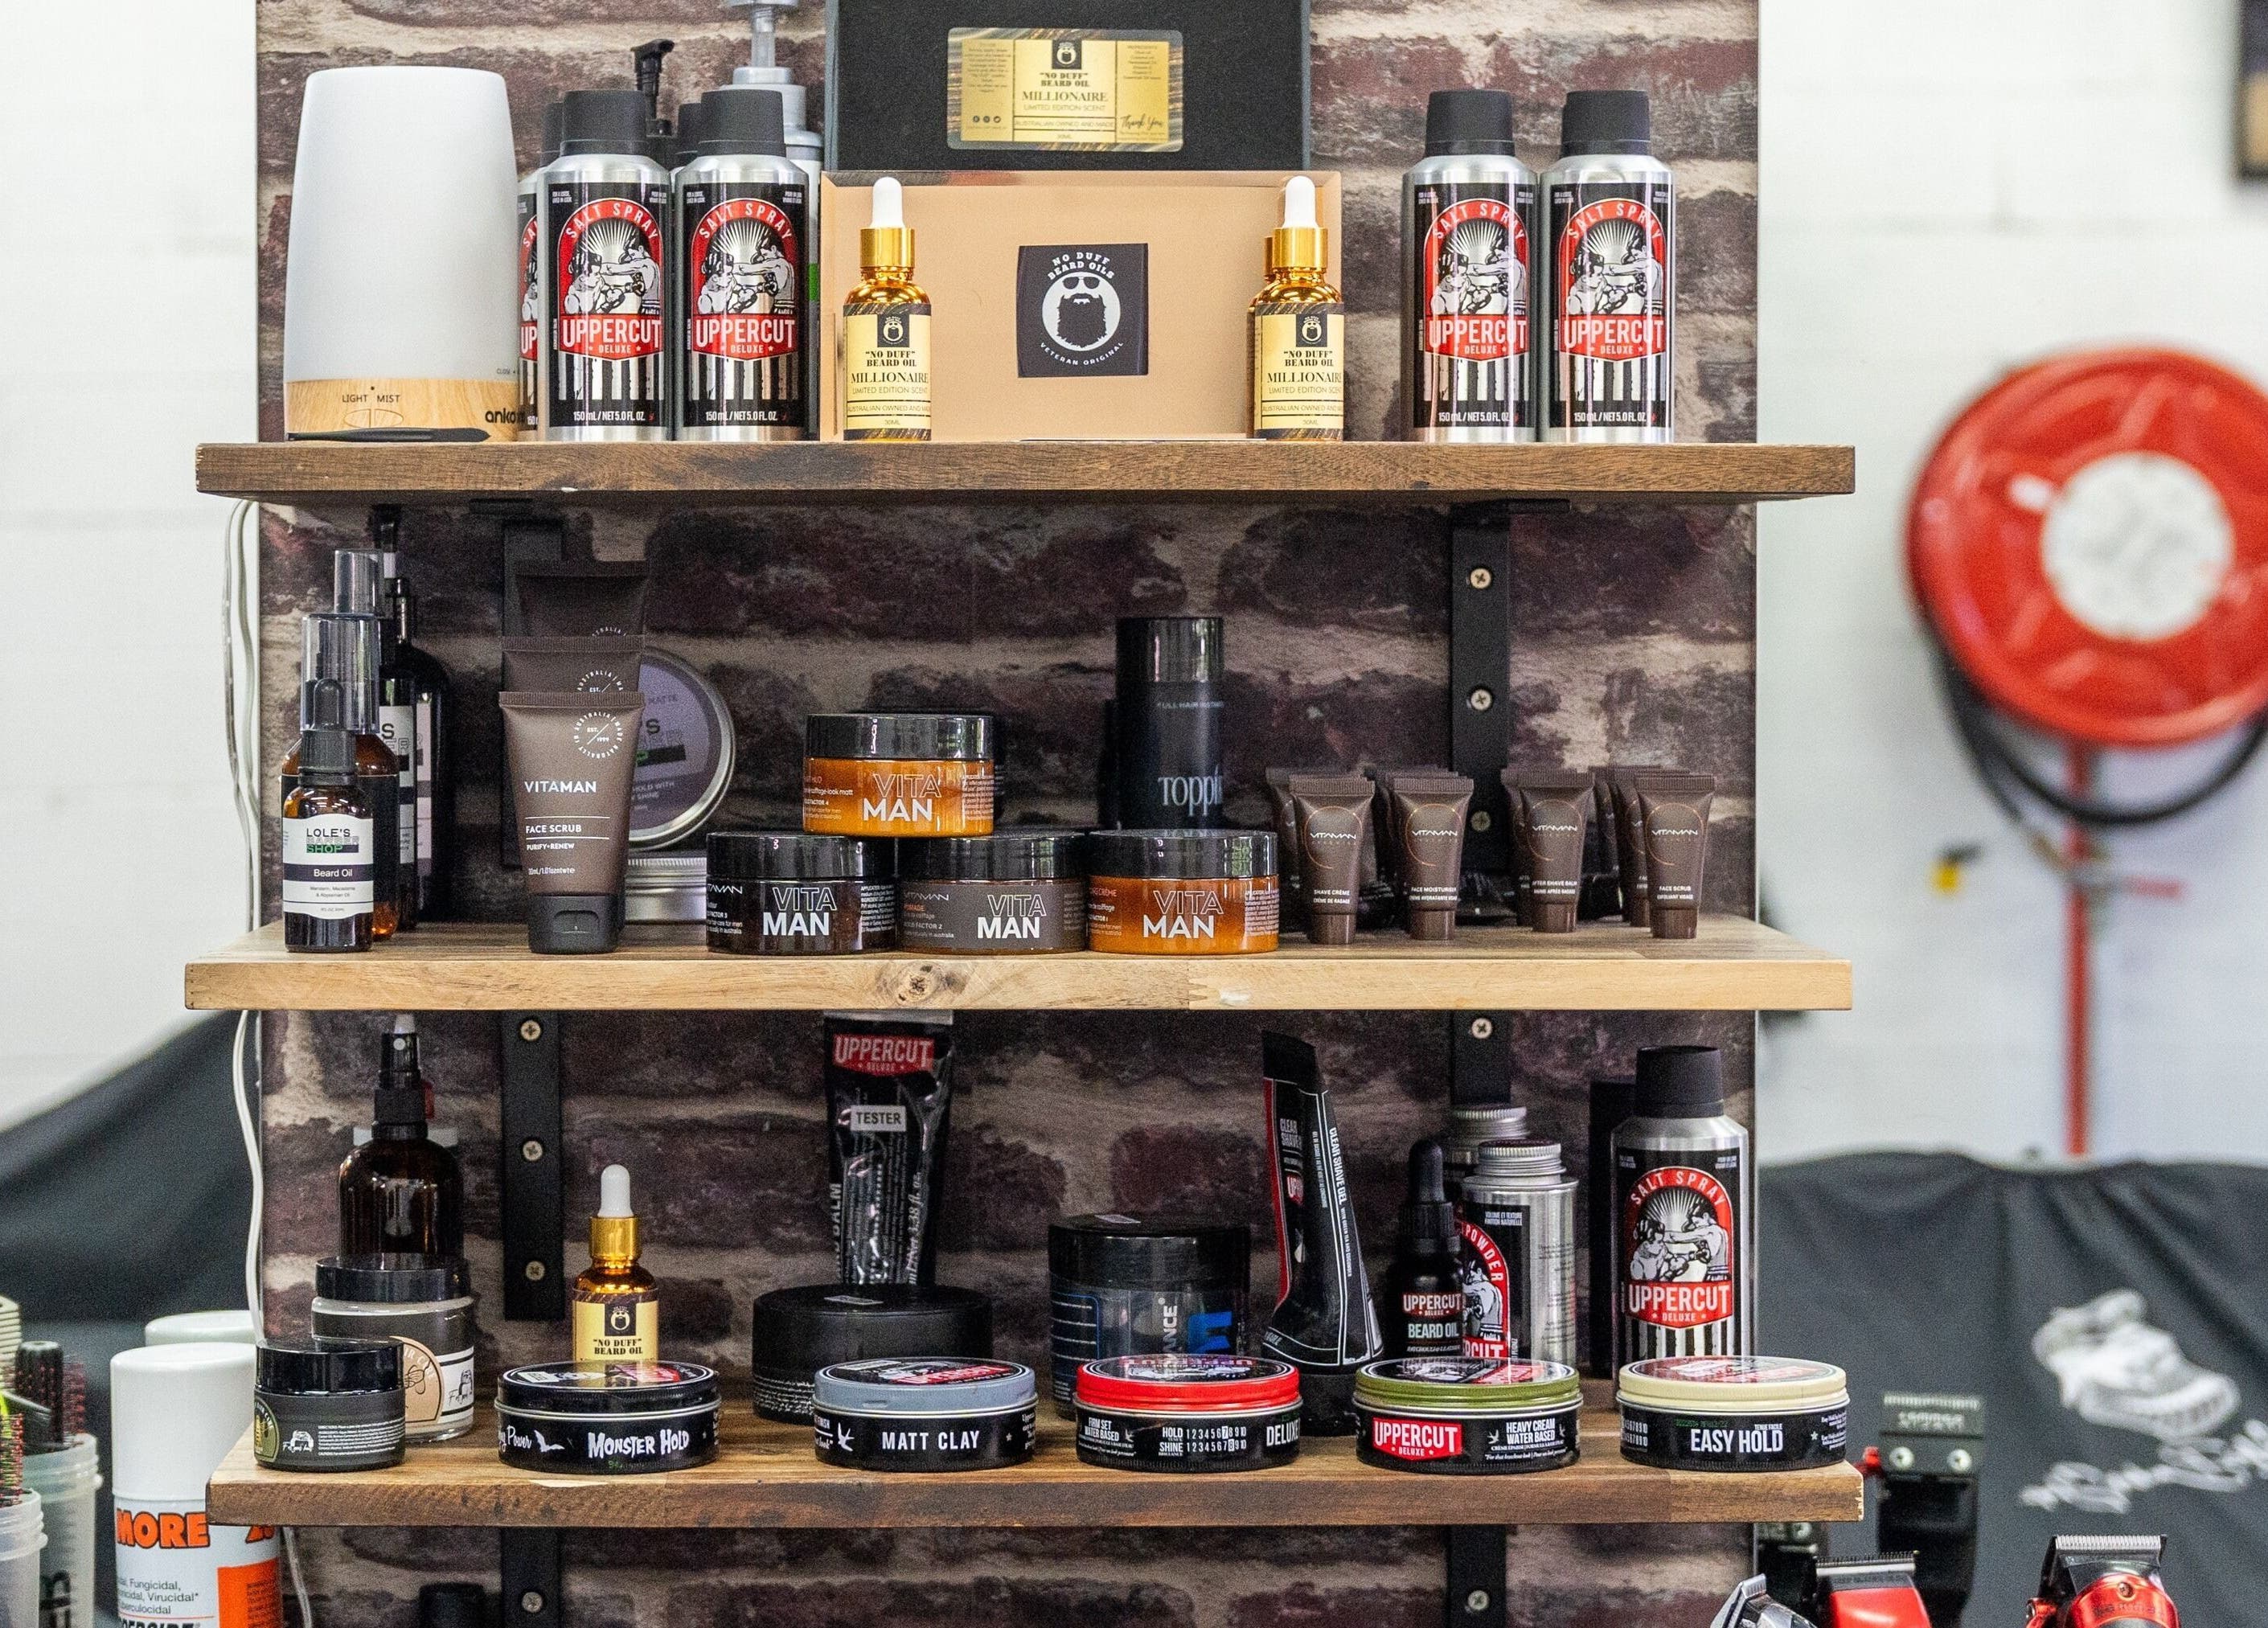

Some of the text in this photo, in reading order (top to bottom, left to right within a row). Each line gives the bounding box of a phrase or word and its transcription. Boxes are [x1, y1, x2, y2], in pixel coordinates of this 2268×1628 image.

[1022, 91, 1109, 102] MILLIONAIRE
[565, 202, 658, 240] SALT SPRAY
[699, 201, 792, 240] SALT SPRAY
[1432, 201, 1524, 240] SALT SPRAY
[1569, 202, 1662, 241] SALT SPRAY
[1052, 252, 1110, 266] NO DUFF
[1047, 260, 1115, 281] BEARD OILS
[563, 318, 662, 348] UPPERCUT
[695, 318, 795, 348] UPPERCUT
[1429, 318, 1527, 349] UPPERCUT
[1564, 318, 1664, 349] UPPERCUT
[598, 344, 632, 354] DELUXE
[730, 344, 764, 354] DELUXE
[1040, 342, 1124, 365] VETERAN ORIGINAL
[1464, 344, 1497, 355] DELUXE
[1600, 344, 1634, 355] DELUXE
[851, 372, 929, 383] MILLIONAIRE
[342, 394, 400, 403] LIGHT MIST
[879, 386, 909, 394] EDITION
[1297, 386, 1327, 394] EDITION
[573, 411, 585, 421] 150
[706, 411, 717, 421] 150
[1438, 411, 1450, 423] 150
[1573, 411, 1586, 423] 150
[524, 781, 597, 793] VITAMAN
[872, 773, 941, 798] VITA
[863, 798, 933, 822] MAN
[306, 828, 351, 837] LOLE'S
[526, 824, 582, 834] FACE SCRUB
[306, 844, 343, 853] SHOP
[314, 868, 353, 877] Beard Oil
[772, 887, 838, 911] VITA
[987, 894, 1047, 917] VITA
[1153, 890, 1224, 915] VITA
[763, 912, 829, 936] MAN
[977, 917, 1040, 939] MAN
[1142, 914, 1214, 938] MAN
[835, 1035, 934, 1068] UPPERCUT
[855, 1112, 901, 1126] TESTER
[1329, 1127, 1342, 1157] CLEAR
[1332, 1157, 1346, 1187] SHAVE
[1337, 1187, 1347, 1205] GEL
[1630, 1171, 1726, 1206] SALT SPRAY
[1465, 1223, 1504, 1282] POWDER
[1403, 1293, 1462, 1312] UPPERCUT
[1629, 1284, 1730, 1314] UPPERCUT
[1662, 1311, 1696, 1322] DELUXE
[1409, 1322, 1459, 1339] BEARD OIL
[593, 1346, 643, 1355] BEARD OIL
[1088, 1417, 1113, 1430] FIRM SET
[1162, 1426, 1183, 1438] HOLD
[1265, 1417, 1300, 1447] DELUXE
[1506, 1417, 1556, 1433] HEAVY CREAM
[507, 1425, 532, 1450] Power
[882, 1430, 980, 1450] MATT CLAY
[1084, 1425, 1120, 1441] WATER BASED
[1374, 1421, 1458, 1453] UPPERCUT
[1506, 1429, 1556, 1445] WATER BASED
[1690, 1429, 1783, 1454] EASY HOLD
[587, 1429, 690, 1459] MONSTER HOLD
[1159, 1441, 1183, 1453] SHINE
[1398, 1446, 1425, 1458] DELUXE
[117, 1507, 211, 1549] MORE
[129, 1578, 181, 1592] Fungicidal,
